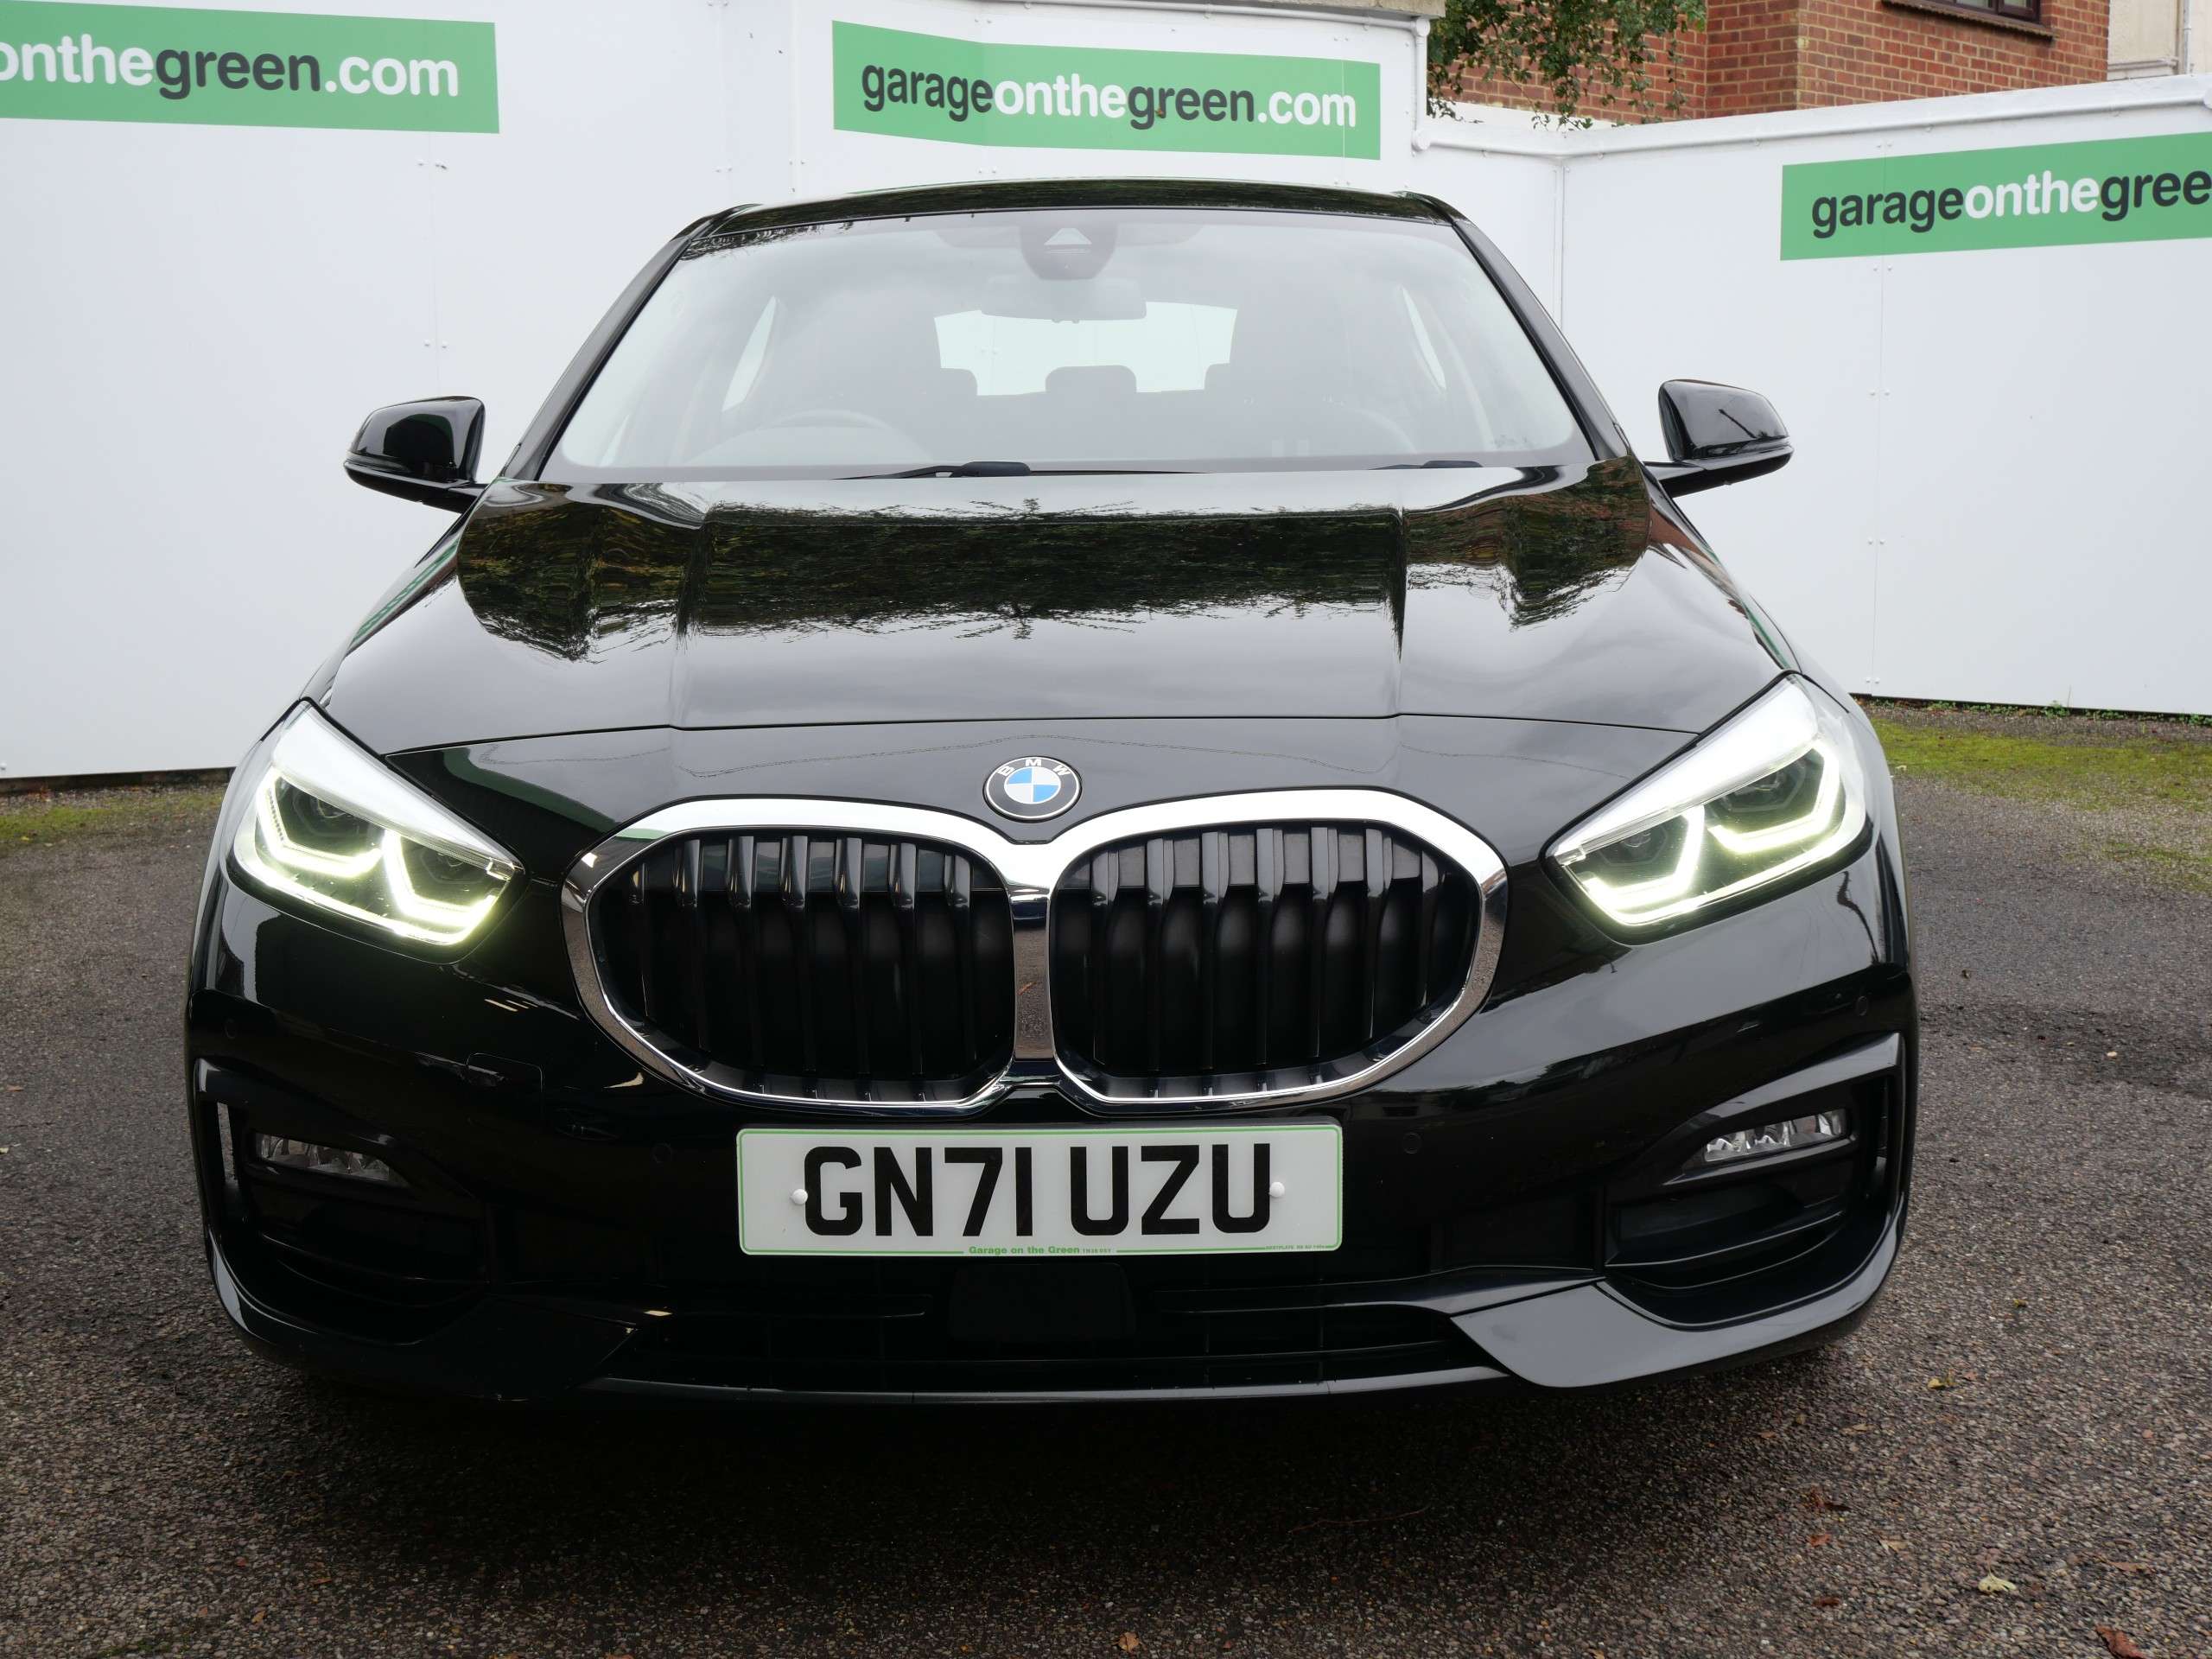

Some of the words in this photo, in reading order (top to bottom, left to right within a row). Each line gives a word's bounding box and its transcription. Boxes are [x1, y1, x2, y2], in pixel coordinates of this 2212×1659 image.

[861, 64, 1357, 130] garageonthegreen.com
[1811, 169, 2212, 239] garageonthegree
[996, 759, 1071, 777] BMW
[804, 1146, 1033, 1237] GN71
[1070, 1143, 1271, 1236] UZU
[969, 1245, 1007, 1255] Garage
[1010, 1246, 1024, 1255] on
[1027, 1245, 1045, 1255] the
[1047, 1245, 1080, 1255] Green
